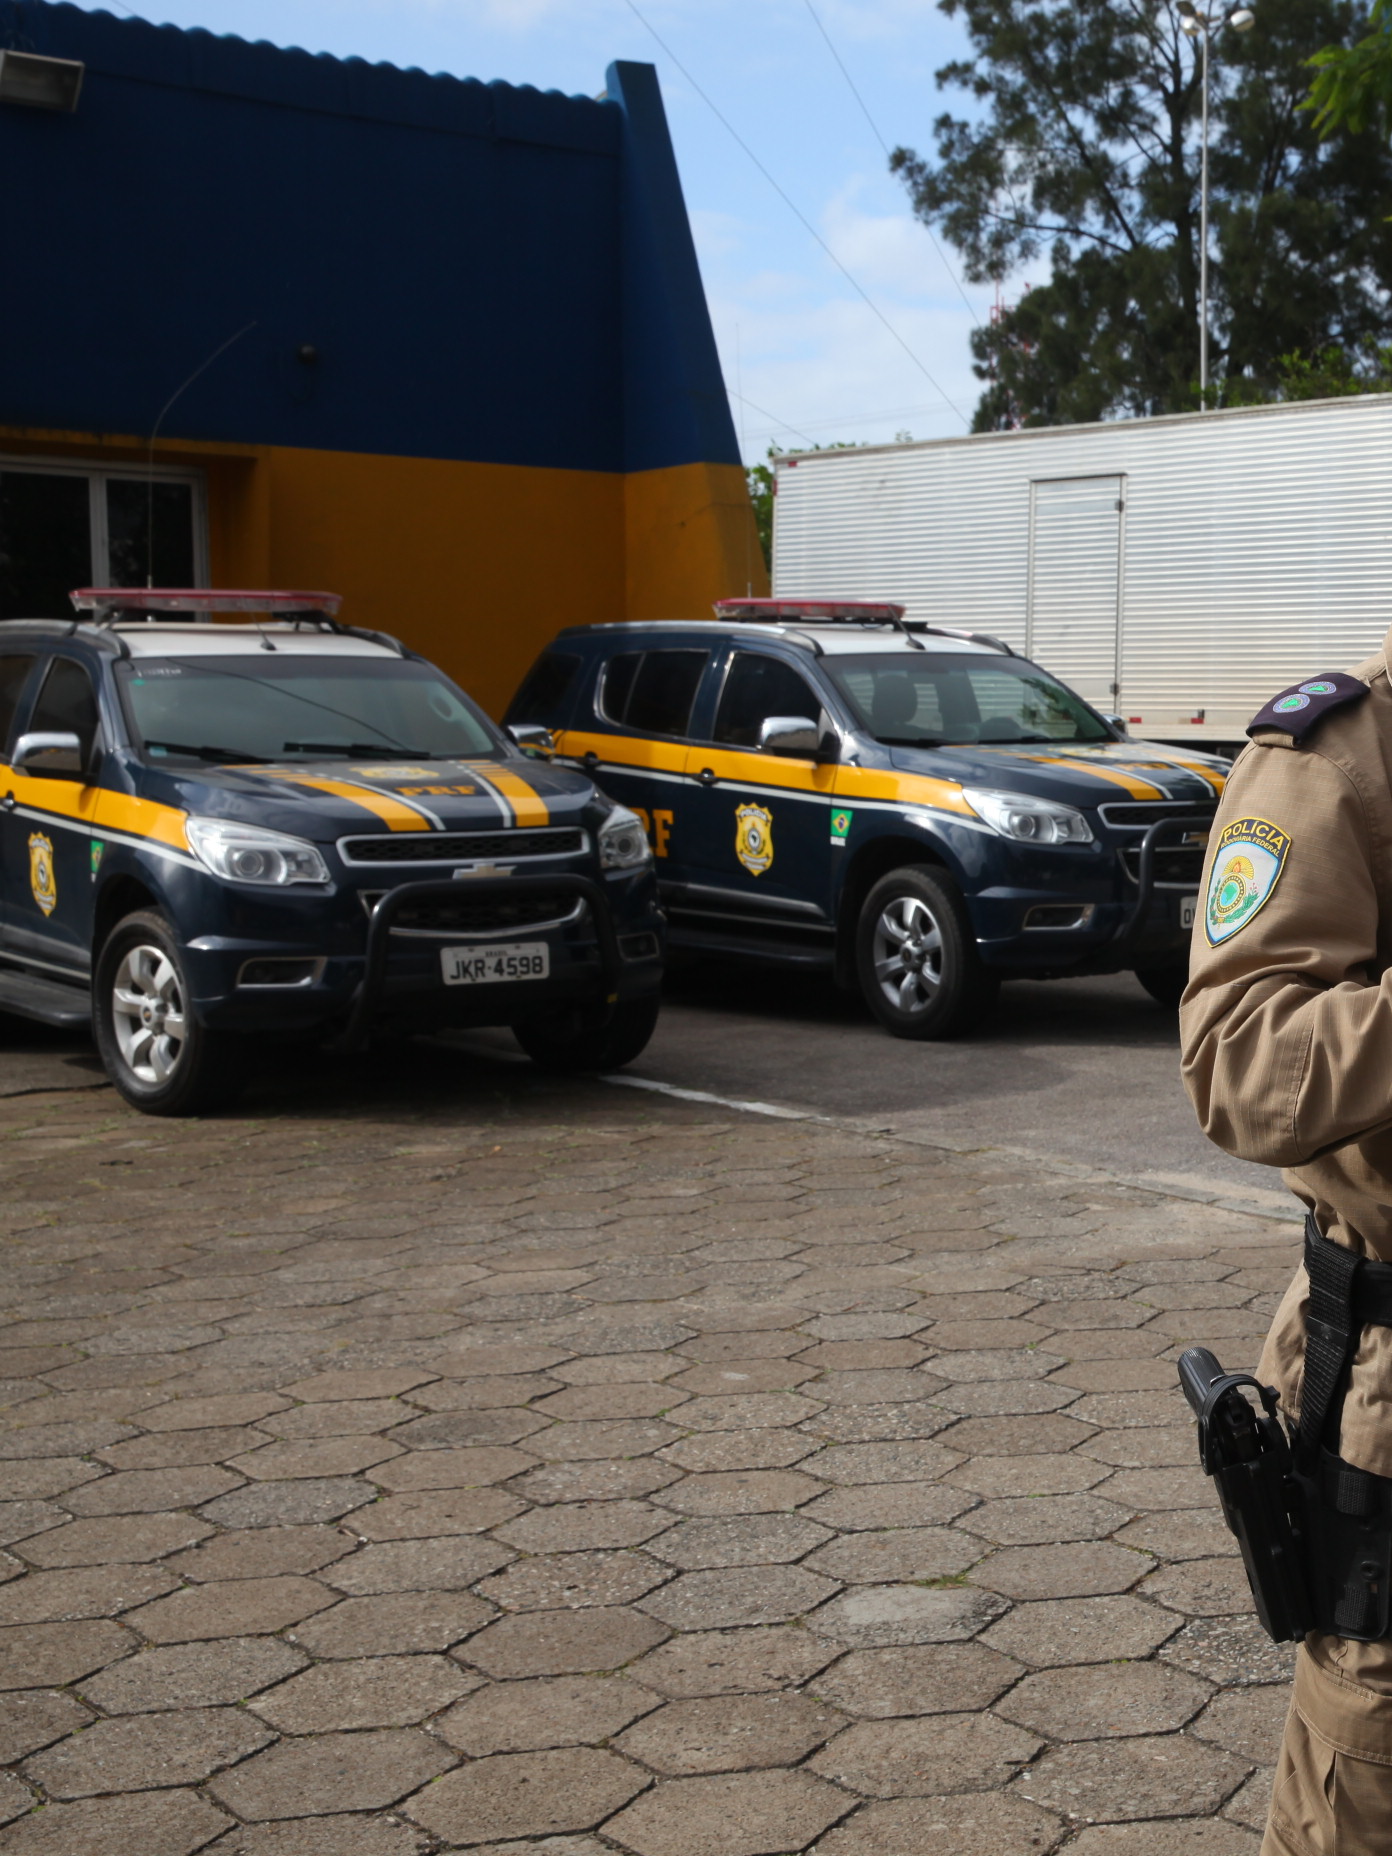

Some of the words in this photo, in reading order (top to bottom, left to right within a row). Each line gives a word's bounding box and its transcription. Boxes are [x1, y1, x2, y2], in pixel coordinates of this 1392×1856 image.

[394, 785, 476, 796] PRF
[1223, 820, 1285, 850] POLÍCIA
[1252, 836, 1280, 857] FEDERAL
